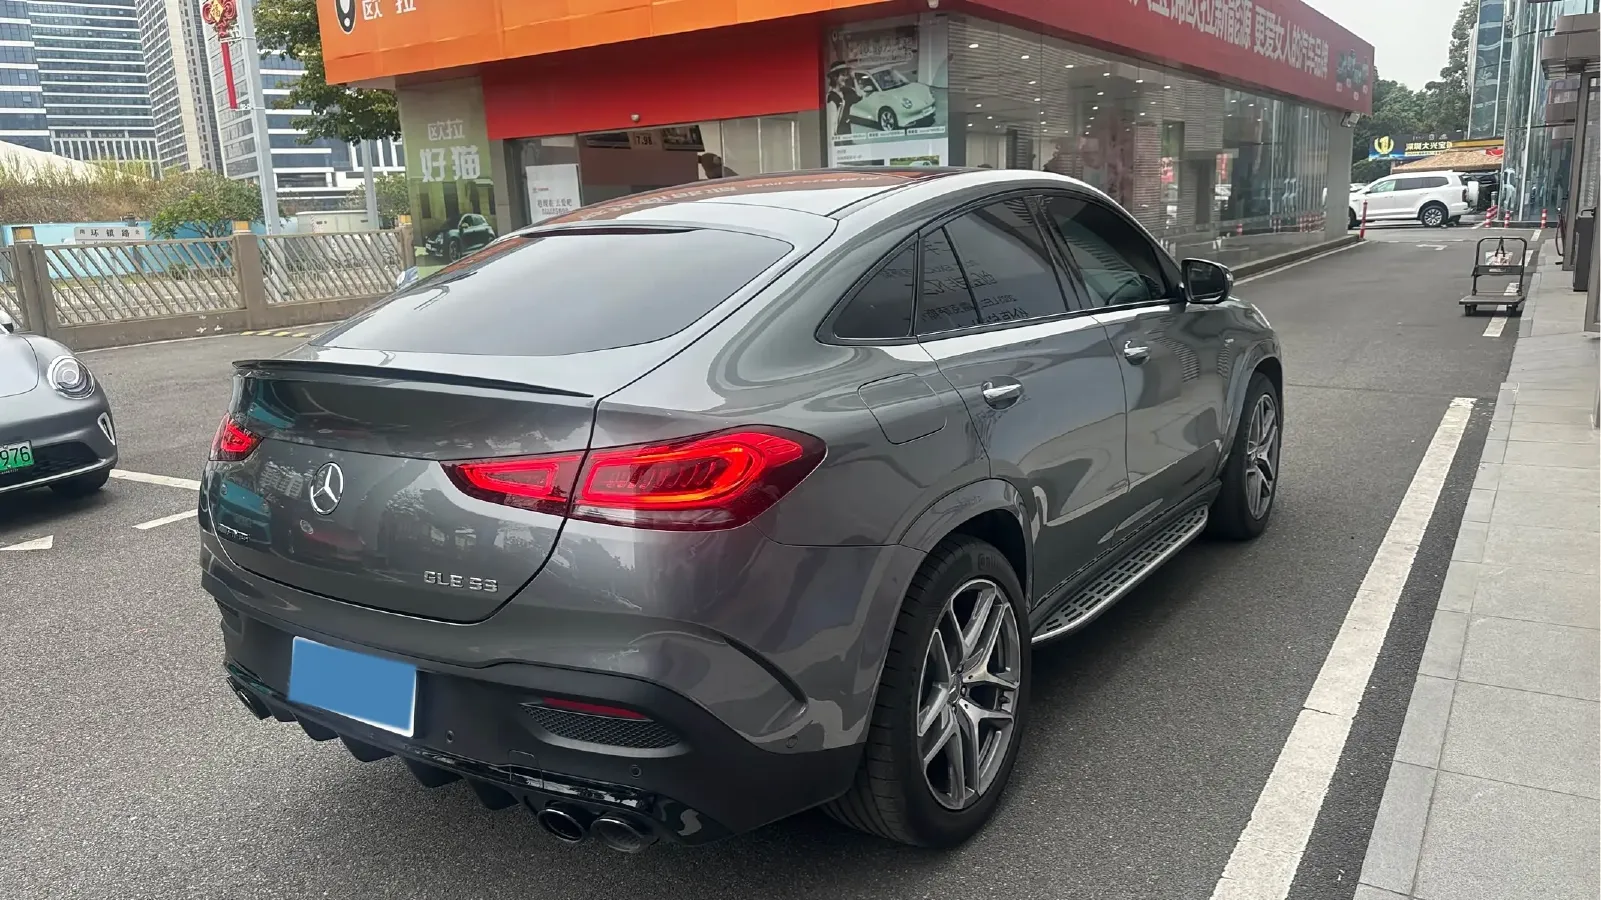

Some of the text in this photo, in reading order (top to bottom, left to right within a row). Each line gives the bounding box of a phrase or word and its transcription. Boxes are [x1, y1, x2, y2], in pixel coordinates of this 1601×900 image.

[1253, 6, 1329, 81] 更爱女人的汽车品牌
[427, 119, 466, 141] 欧拉
[419, 145, 481, 182] 好猫
[424, 570, 464, 588] GLE
